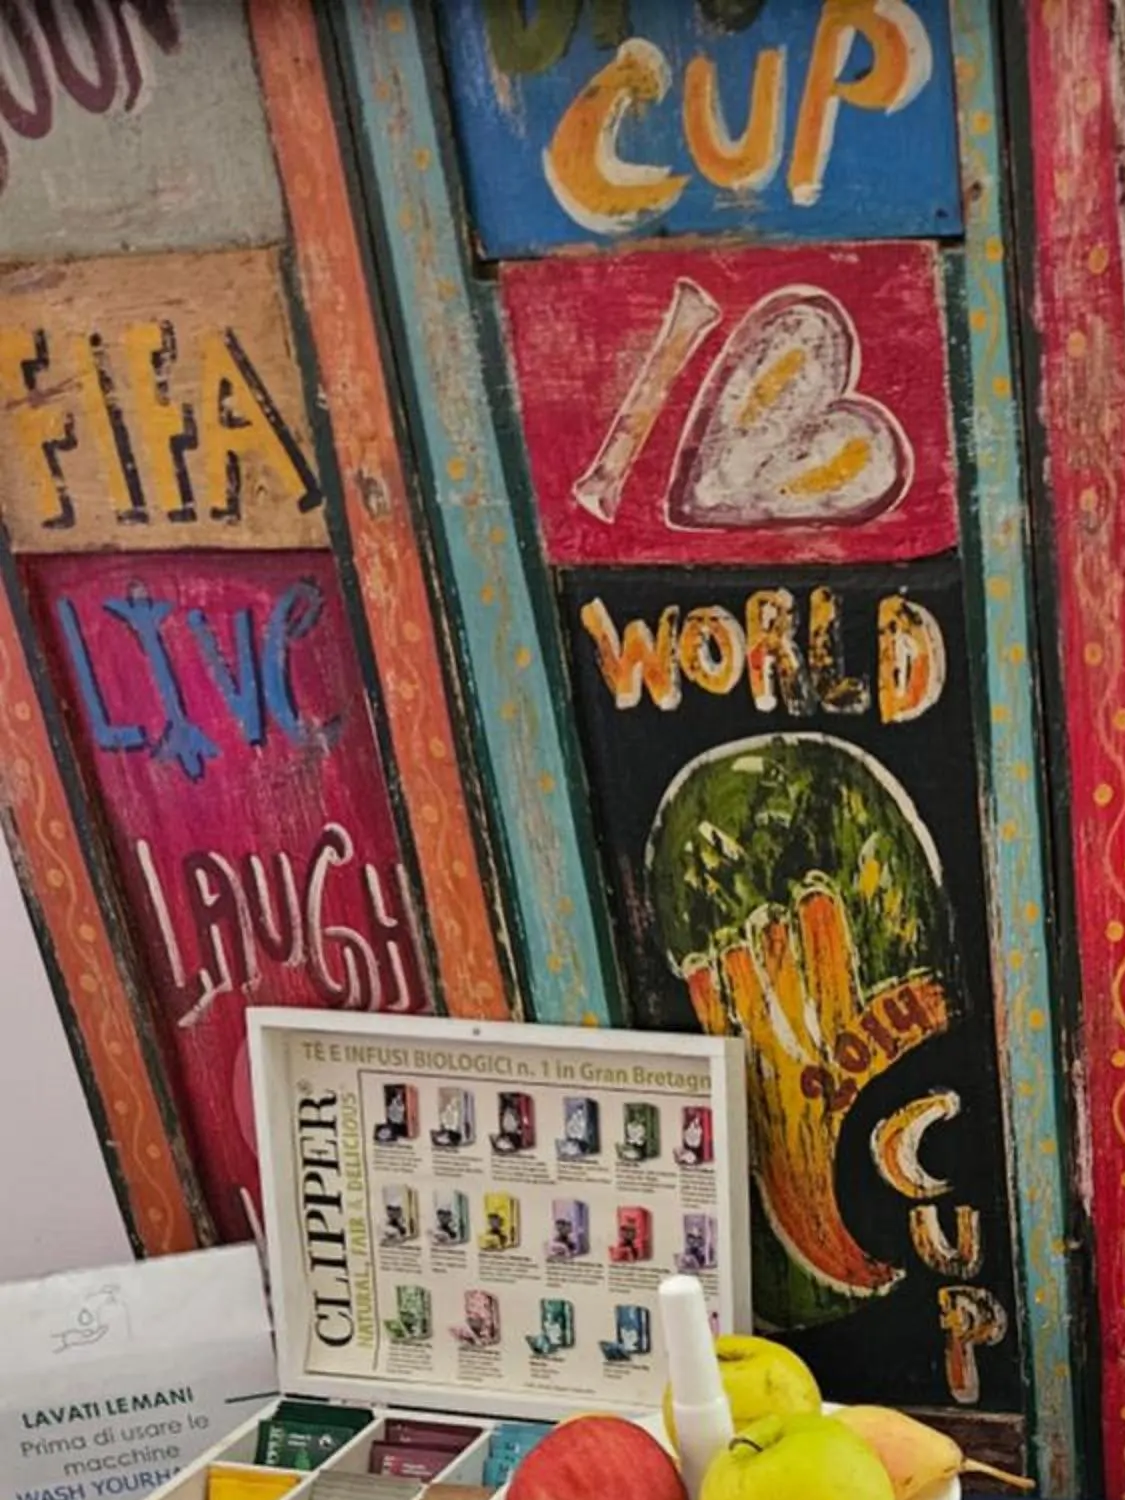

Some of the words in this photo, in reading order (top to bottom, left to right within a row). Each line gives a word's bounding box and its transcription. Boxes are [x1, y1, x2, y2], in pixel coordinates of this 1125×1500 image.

[542, 0, 933, 234] CUP
[0, 318, 322, 528] FIFA
[581, 585, 946, 723] WORLD
[137, 822, 428, 1028] LAUGH
[330, 1044, 341, 1062] E
[345, 1044, 410, 1067] INFUSI
[414, 1048, 513, 1076] BIOLOGICI
[517, 1063, 535, 1077] n.
[556, 1058, 575, 1080] in
[579, 1063, 629, 1084] Gran
[801, 986, 930, 1113] 2014
[341, 1091, 364, 1192] DELICIOUS
[347, 1216, 368, 1257] FAIR
[20, 1435, 87, 1457] Prima
[93, 1427, 116, 1447] di
[120, 1417, 183, 1443] usare
[186, 1412, 210, 1430] le
[21, 1402, 100, 1429] LAVATI
[63, 1445, 181, 1477] macchine
